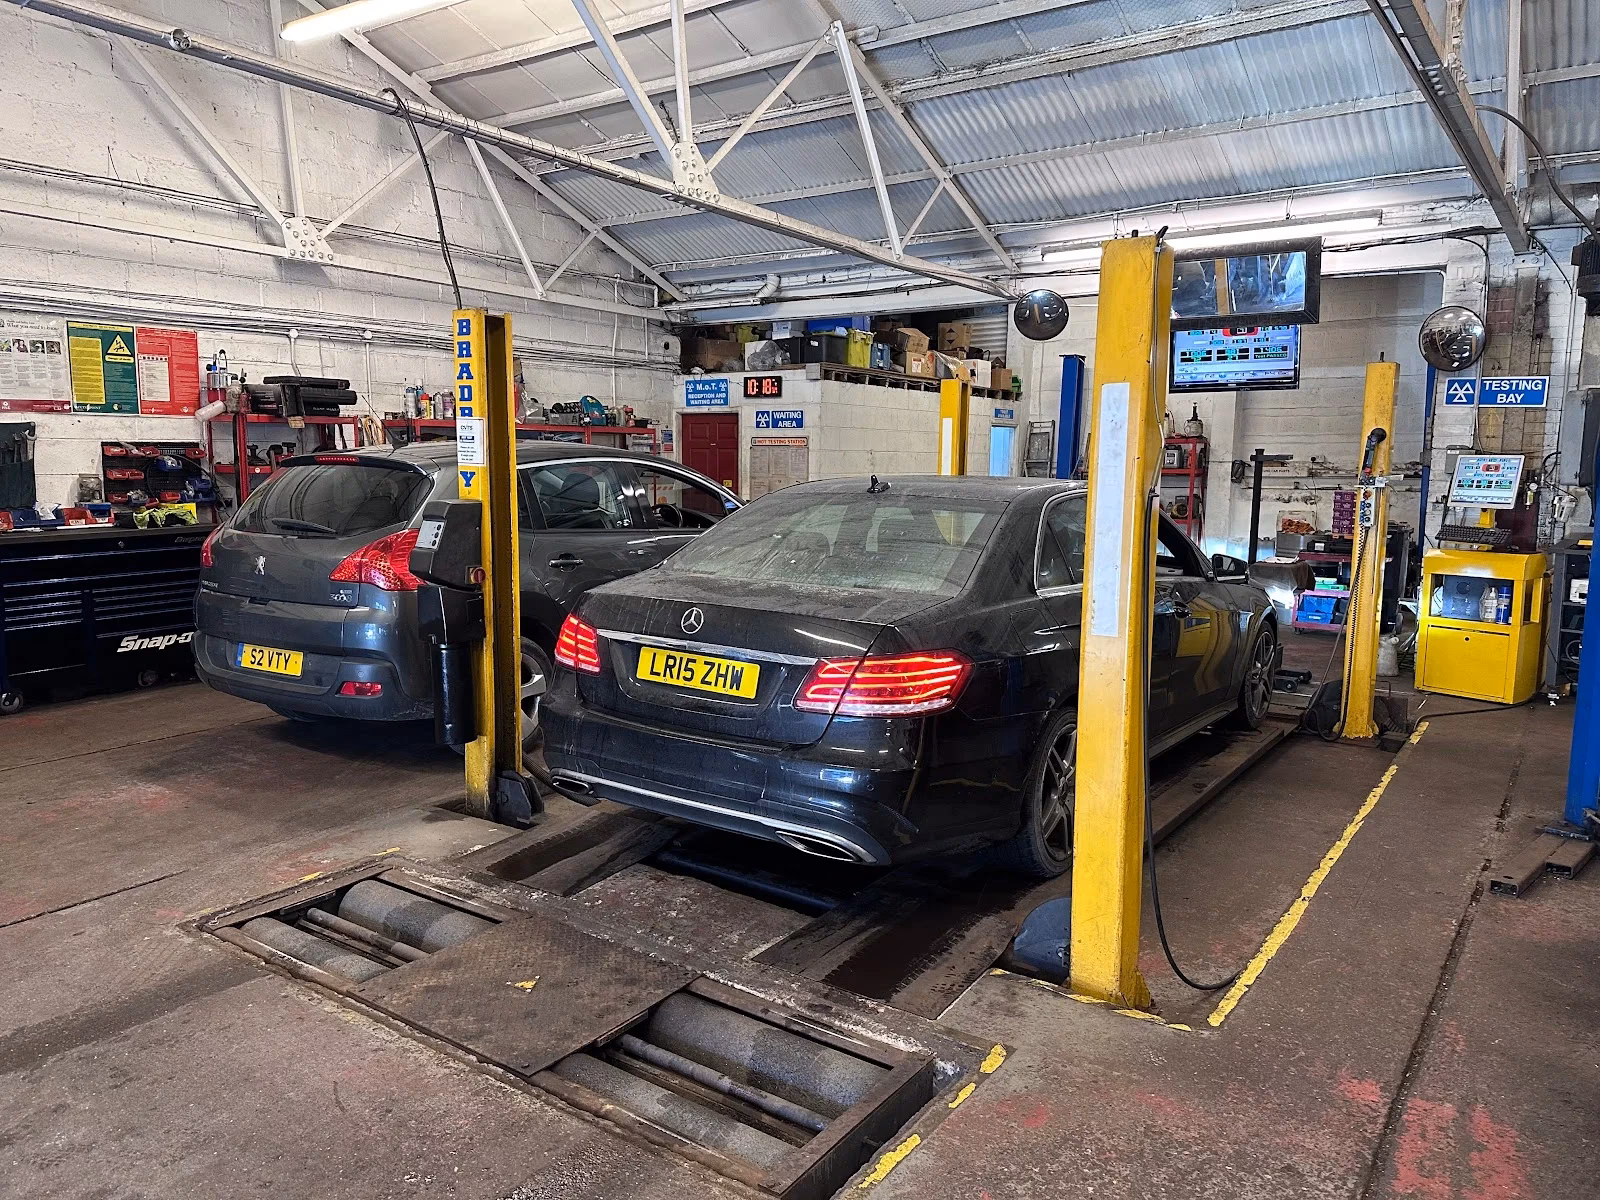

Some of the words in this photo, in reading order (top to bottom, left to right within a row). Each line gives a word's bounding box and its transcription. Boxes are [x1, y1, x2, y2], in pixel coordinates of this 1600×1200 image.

[696, 382, 718, 391] M.o.T.
[747, 378, 772, 395] 10:18
[1483, 380, 1543, 391] TESTING
[456, 318, 475, 488] BRADBY
[1496, 393, 1524, 404] BAY
[773, 411, 802, 420] WAITING
[778, 420, 797, 428] AREA
[117, 632, 194, 652] Snap-o
[250, 648, 264, 666] S2
[268, 650, 291, 670] VTY
[650, 652, 697, 682] LR15
[700, 660, 744, 691] ZHW
